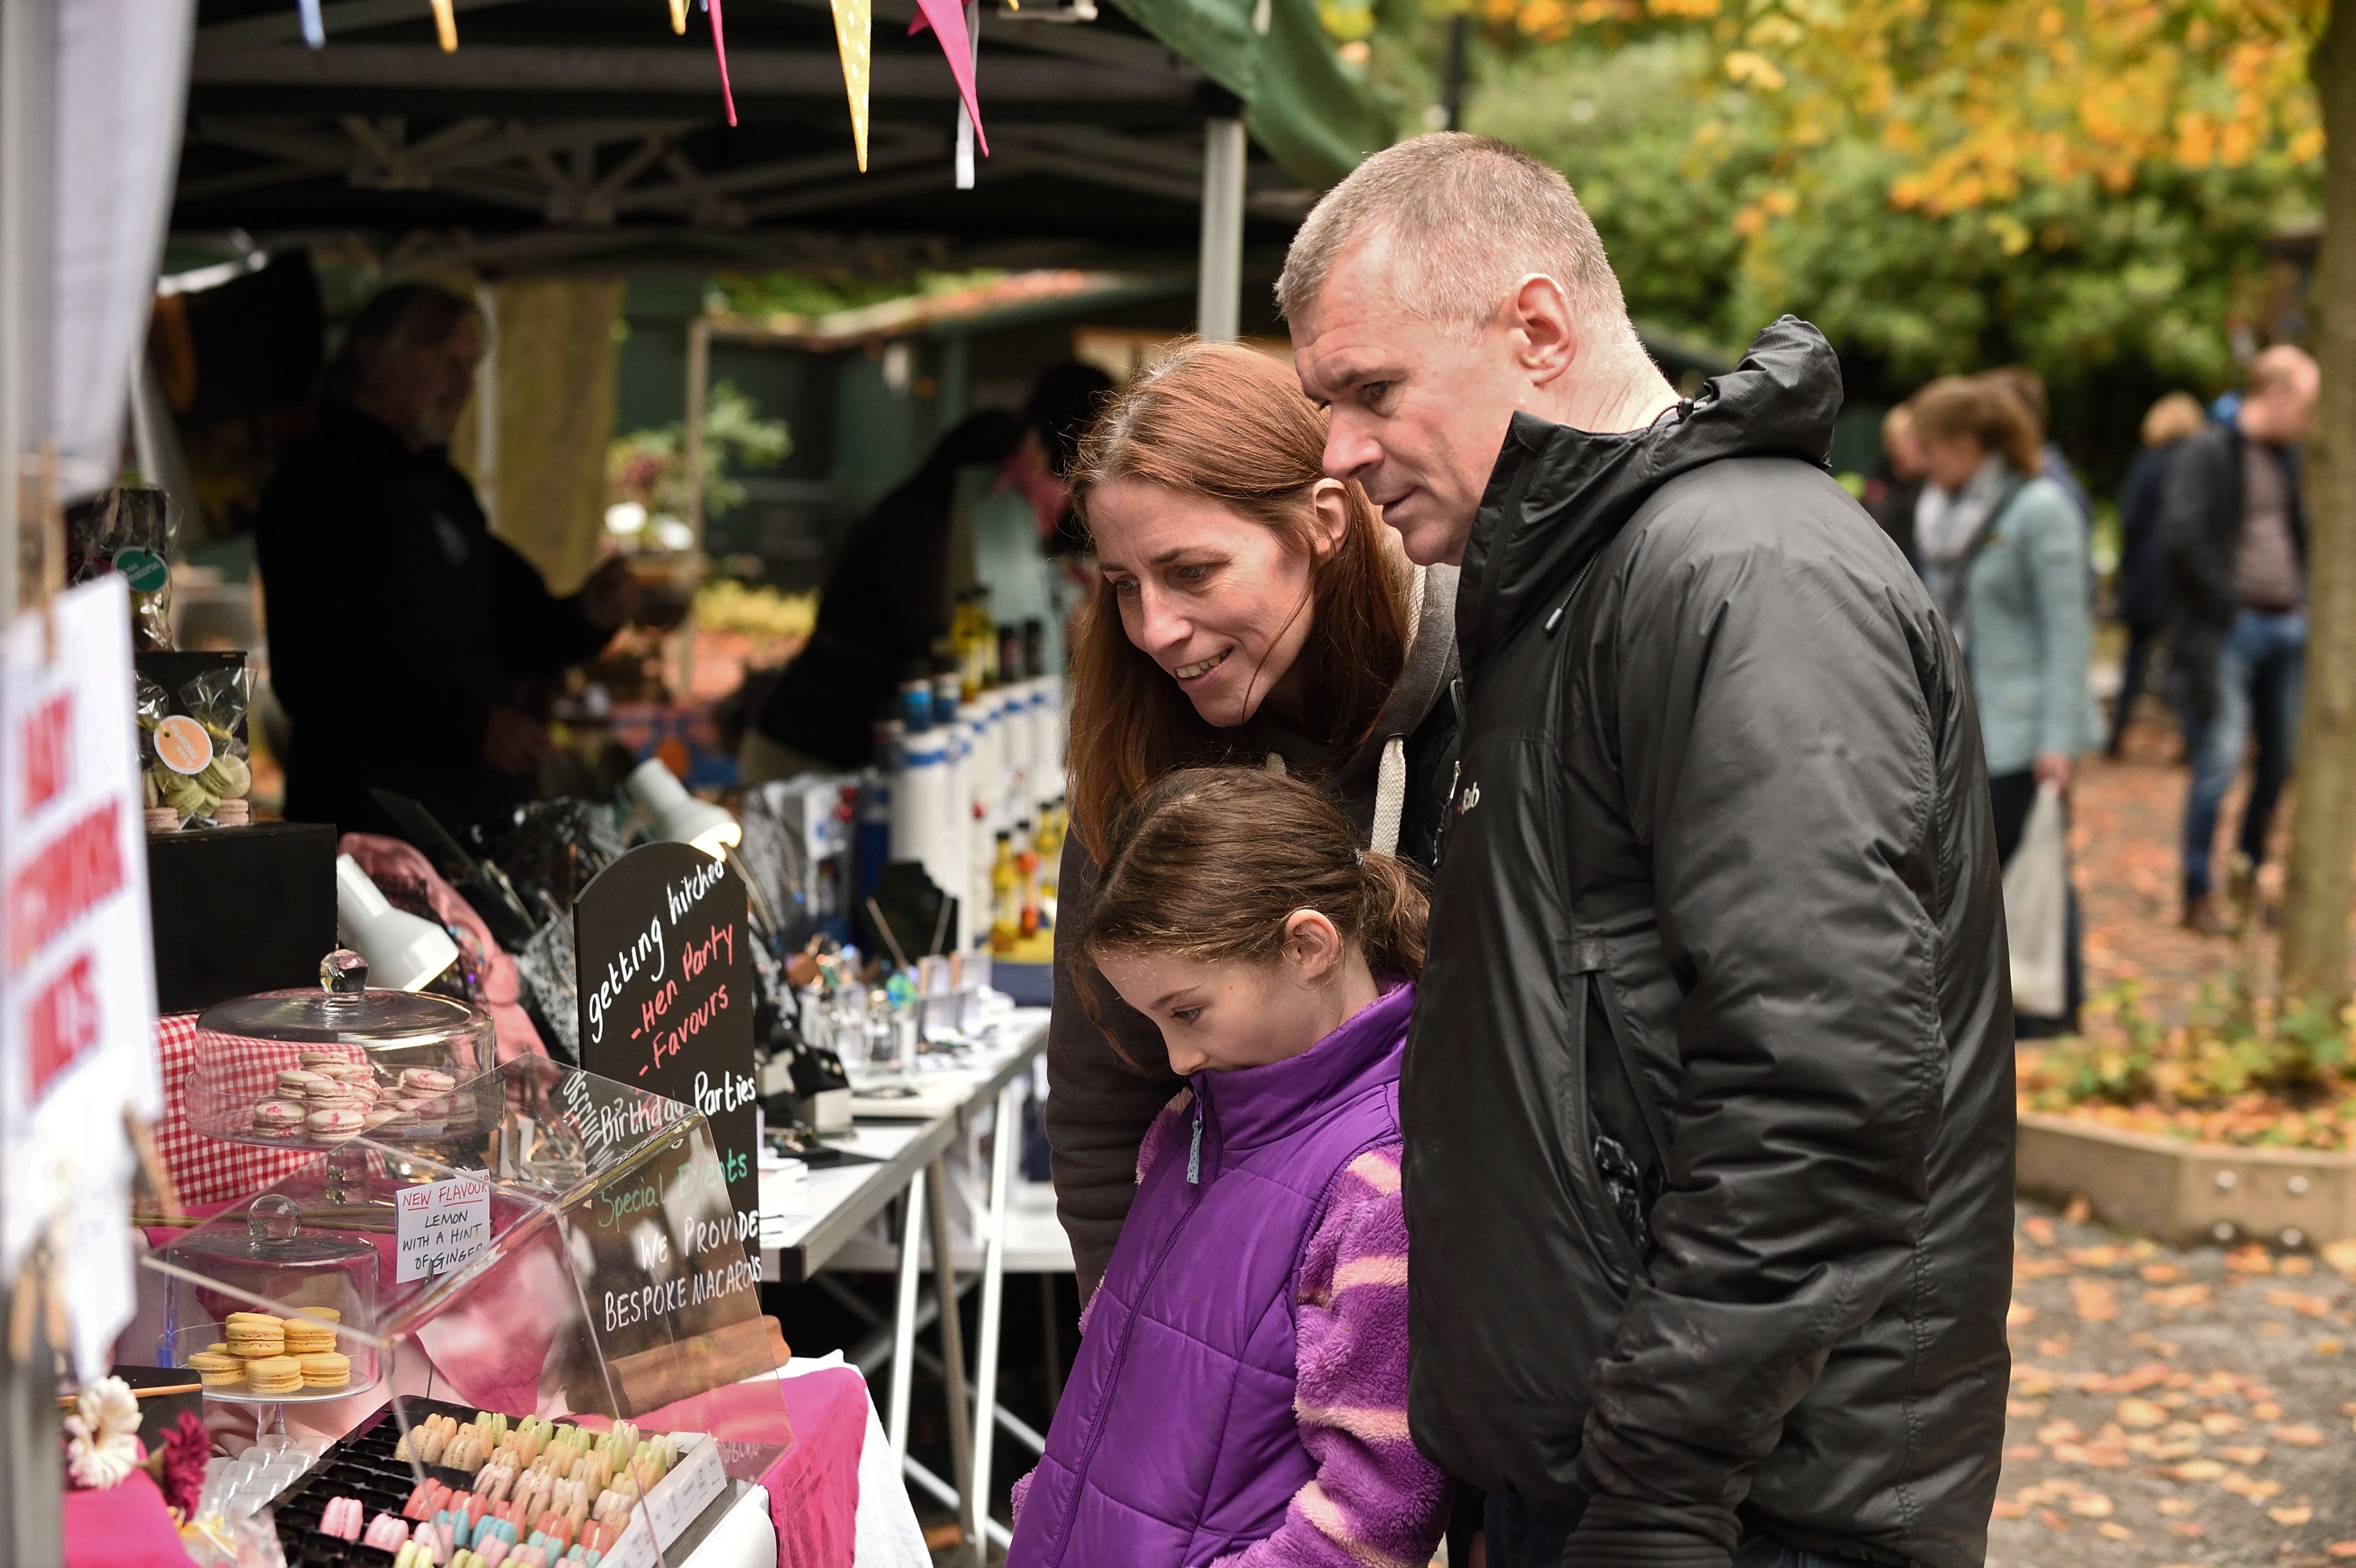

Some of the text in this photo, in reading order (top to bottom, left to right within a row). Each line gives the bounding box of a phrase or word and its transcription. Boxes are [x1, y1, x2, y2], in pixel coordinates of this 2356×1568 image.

[682, 924, 733, 981] Party
[589, 915, 664, 1044] getting
[694, 1071, 756, 1116] Parties
[403, 1190, 432, 1207] NEW
[425, 1210, 468, 1229] LEMON
[598, 1172, 666, 1233] Special
[403, 1223, 482, 1252] WITH A HINT
[415, 1253, 429, 1270] OF
[640, 1210, 760, 1269] WE PROVIDE
[605, 1277, 686, 1332] BESPOKE
